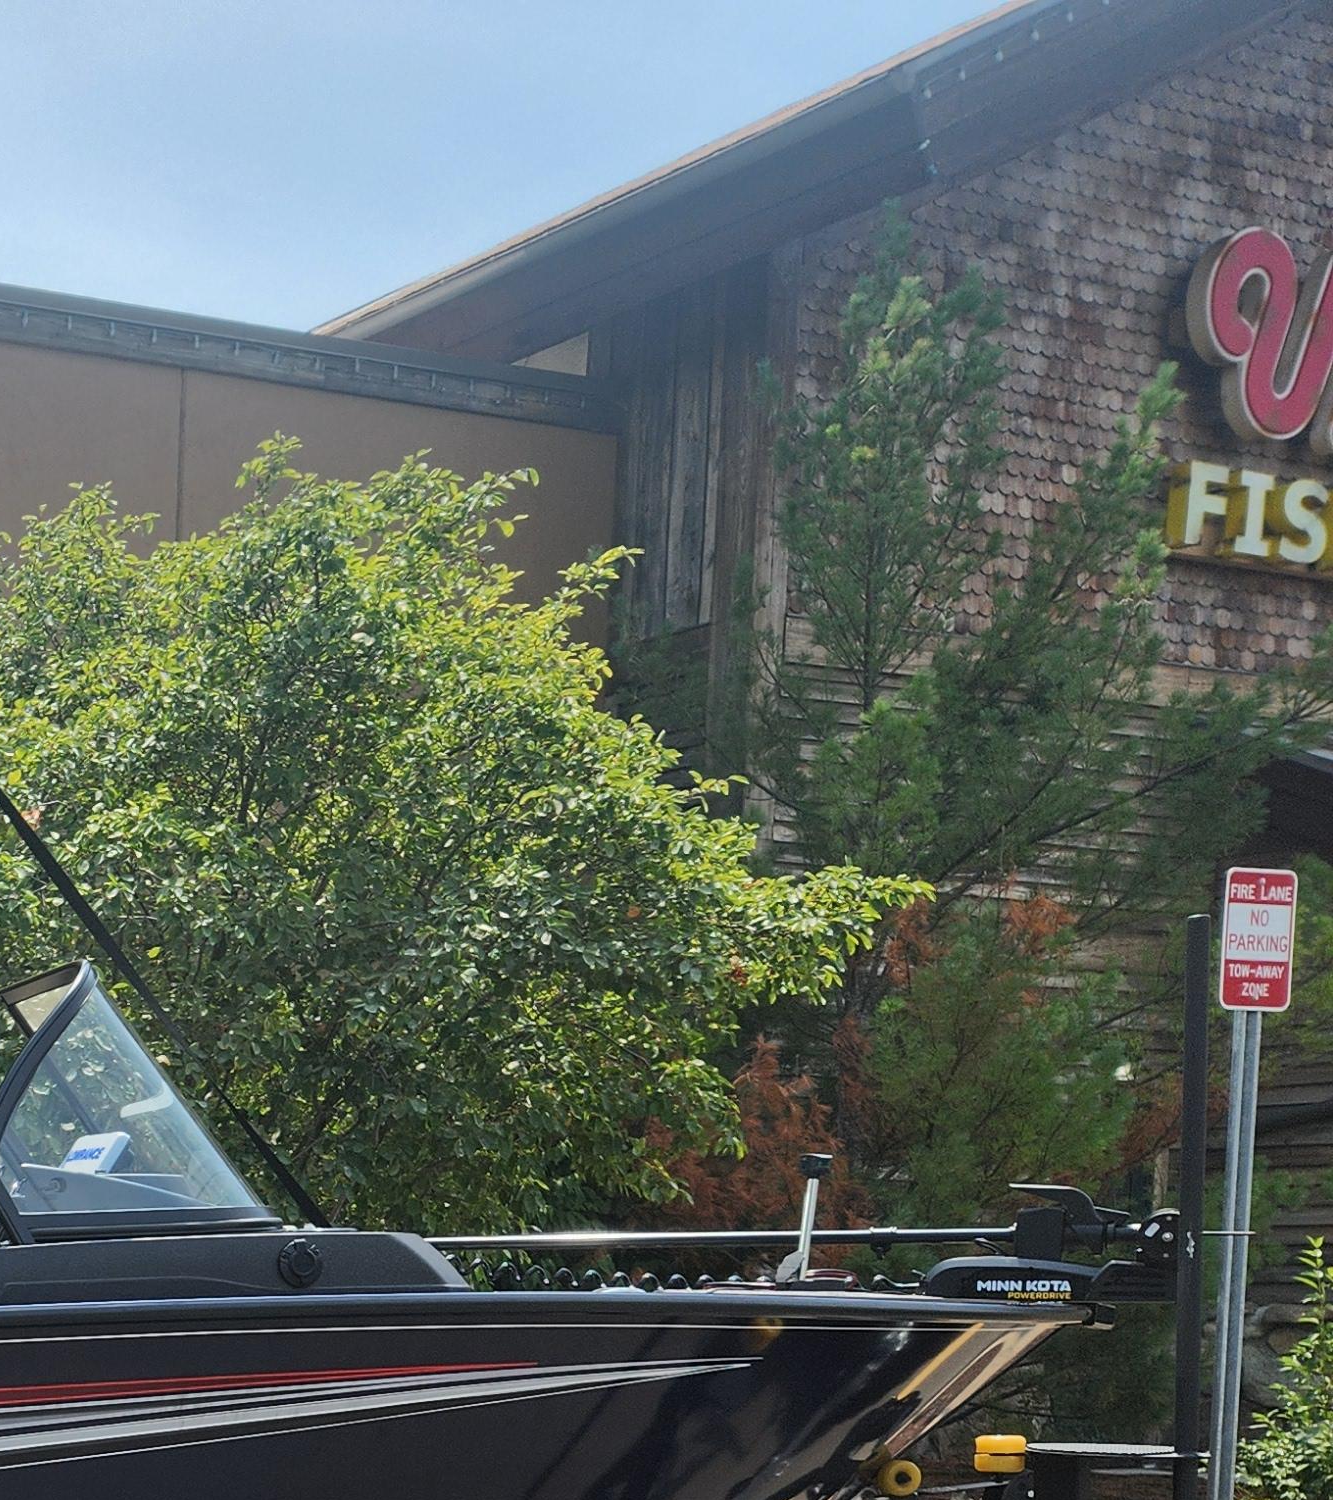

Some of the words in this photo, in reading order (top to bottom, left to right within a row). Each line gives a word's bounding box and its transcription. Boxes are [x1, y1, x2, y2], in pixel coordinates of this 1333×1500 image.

[1231, 883, 1256, 900] FIRE
[1260, 884, 1293, 901] LANE
[1250, 909, 1269, 927] NO
[1229, 933, 1288, 953] PARKING
[1229, 963, 1284, 979] TOW-AWAY
[1241, 982, 1269, 998] ZONE
[976, 1280, 1022, 1292] MINN
[1026, 1280, 1072, 1292] KOTA
[1008, 1292, 1072, 1300] POWERDRIVE
